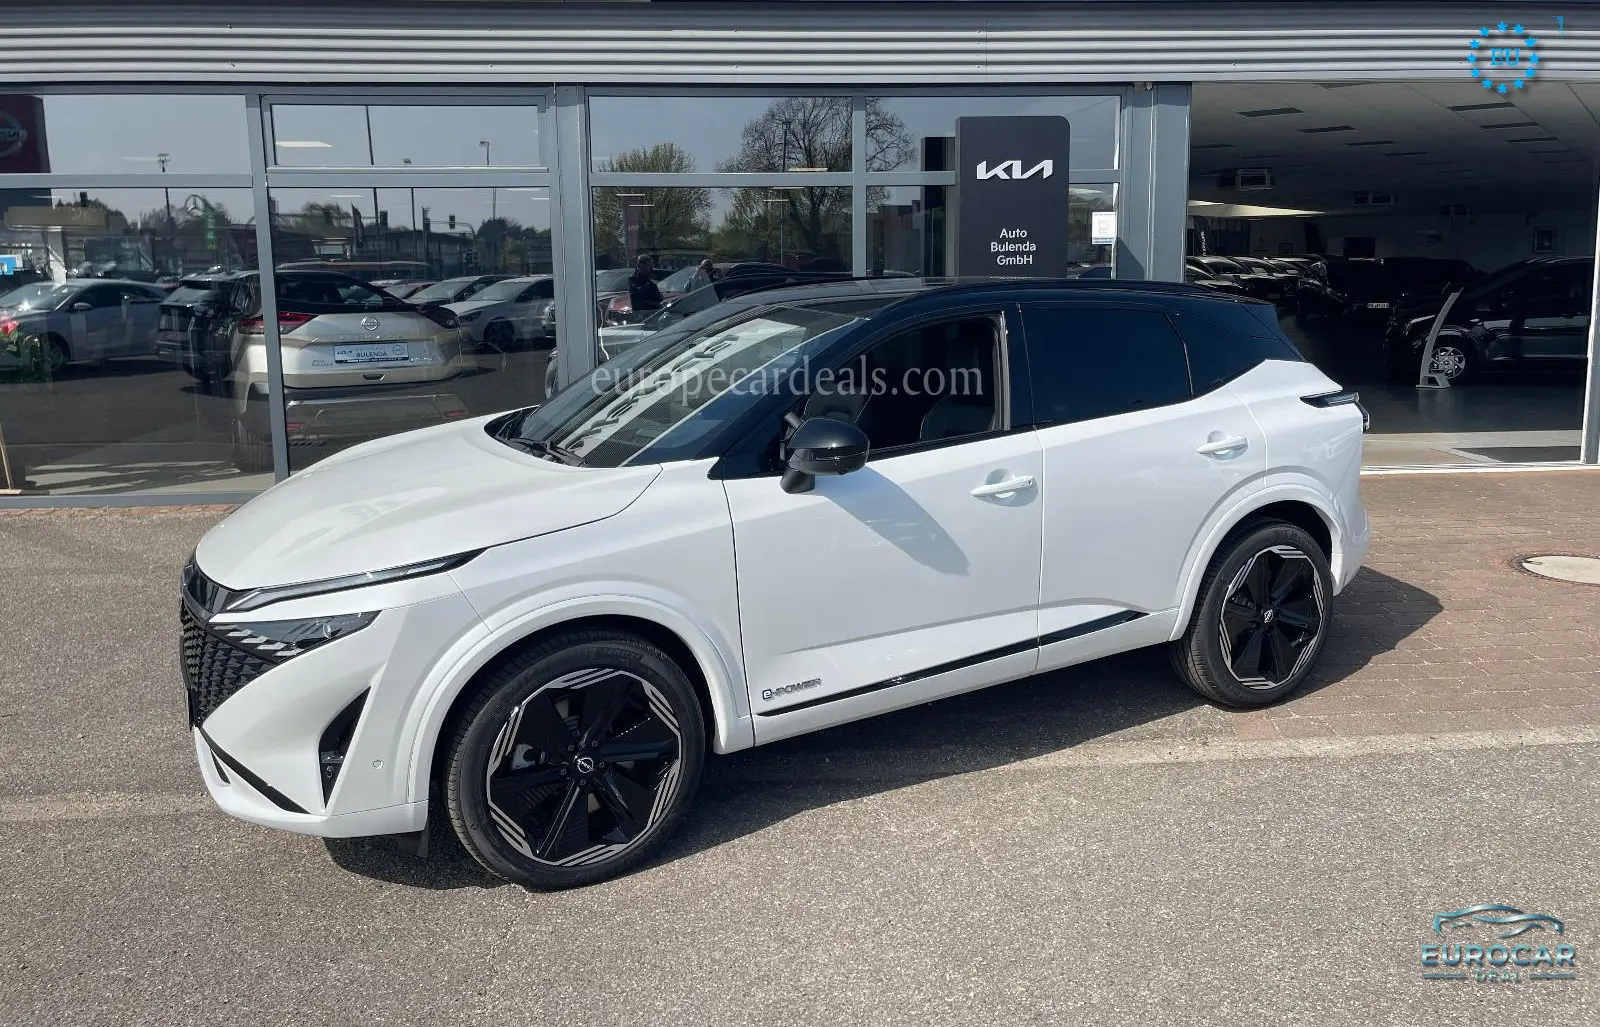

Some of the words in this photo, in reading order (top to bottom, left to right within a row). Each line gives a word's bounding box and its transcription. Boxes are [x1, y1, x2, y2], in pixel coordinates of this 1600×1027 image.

[976, 159, 1054, 180] KIA
[999, 228, 1028, 239] Auto
[990, 241, 1037, 252] Bulenda
[996, 254, 1033, 266] GmbH
